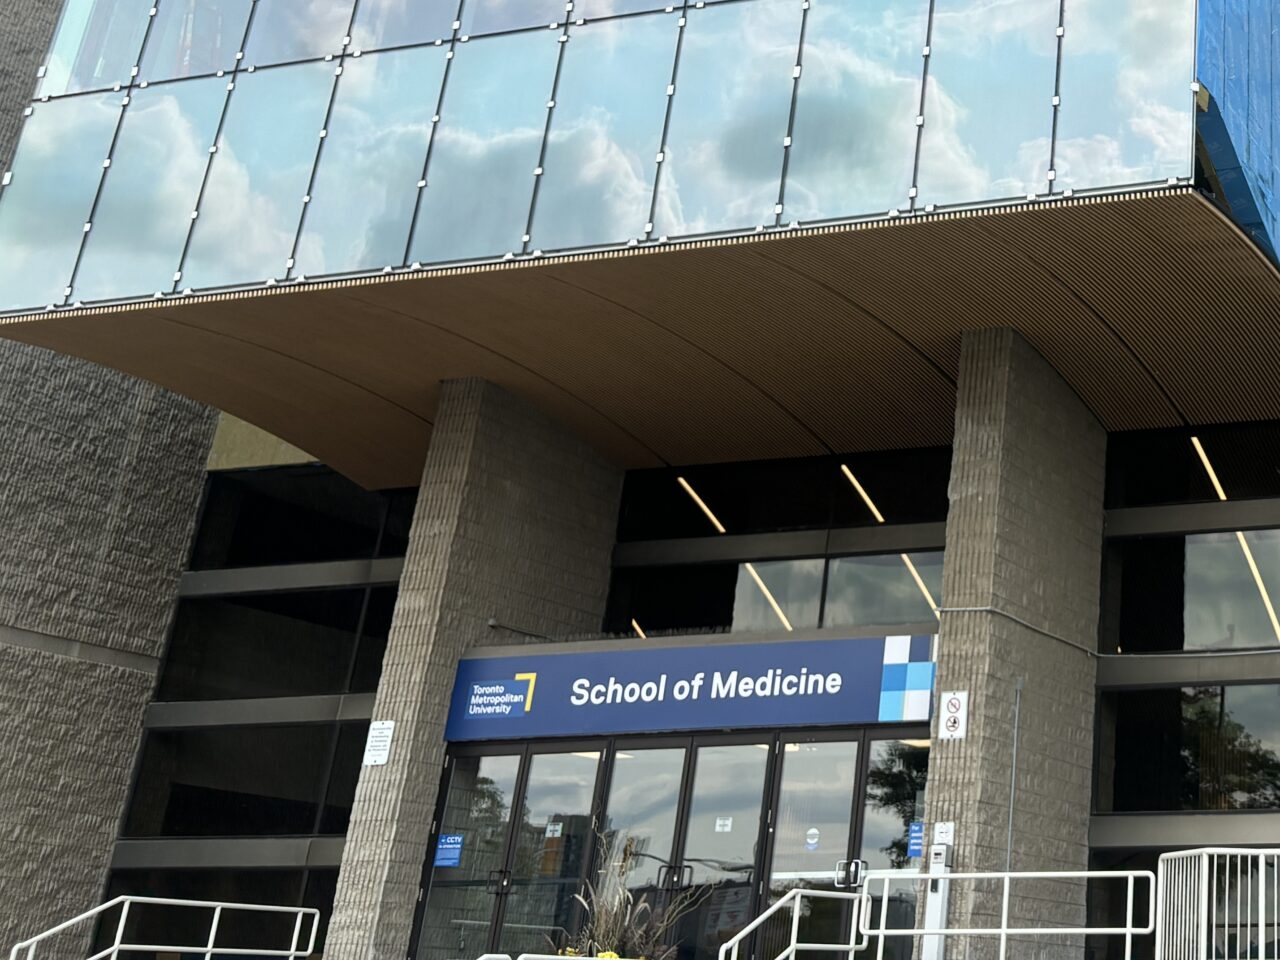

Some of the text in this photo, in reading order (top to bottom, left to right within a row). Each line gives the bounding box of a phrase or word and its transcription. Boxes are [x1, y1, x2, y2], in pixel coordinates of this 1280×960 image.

[473, 685, 505, 694] Toronto
[570, 668, 842, 706] School of Medicine
[471, 694, 524, 705] Metropolitan
[469, 704, 511, 714] University
